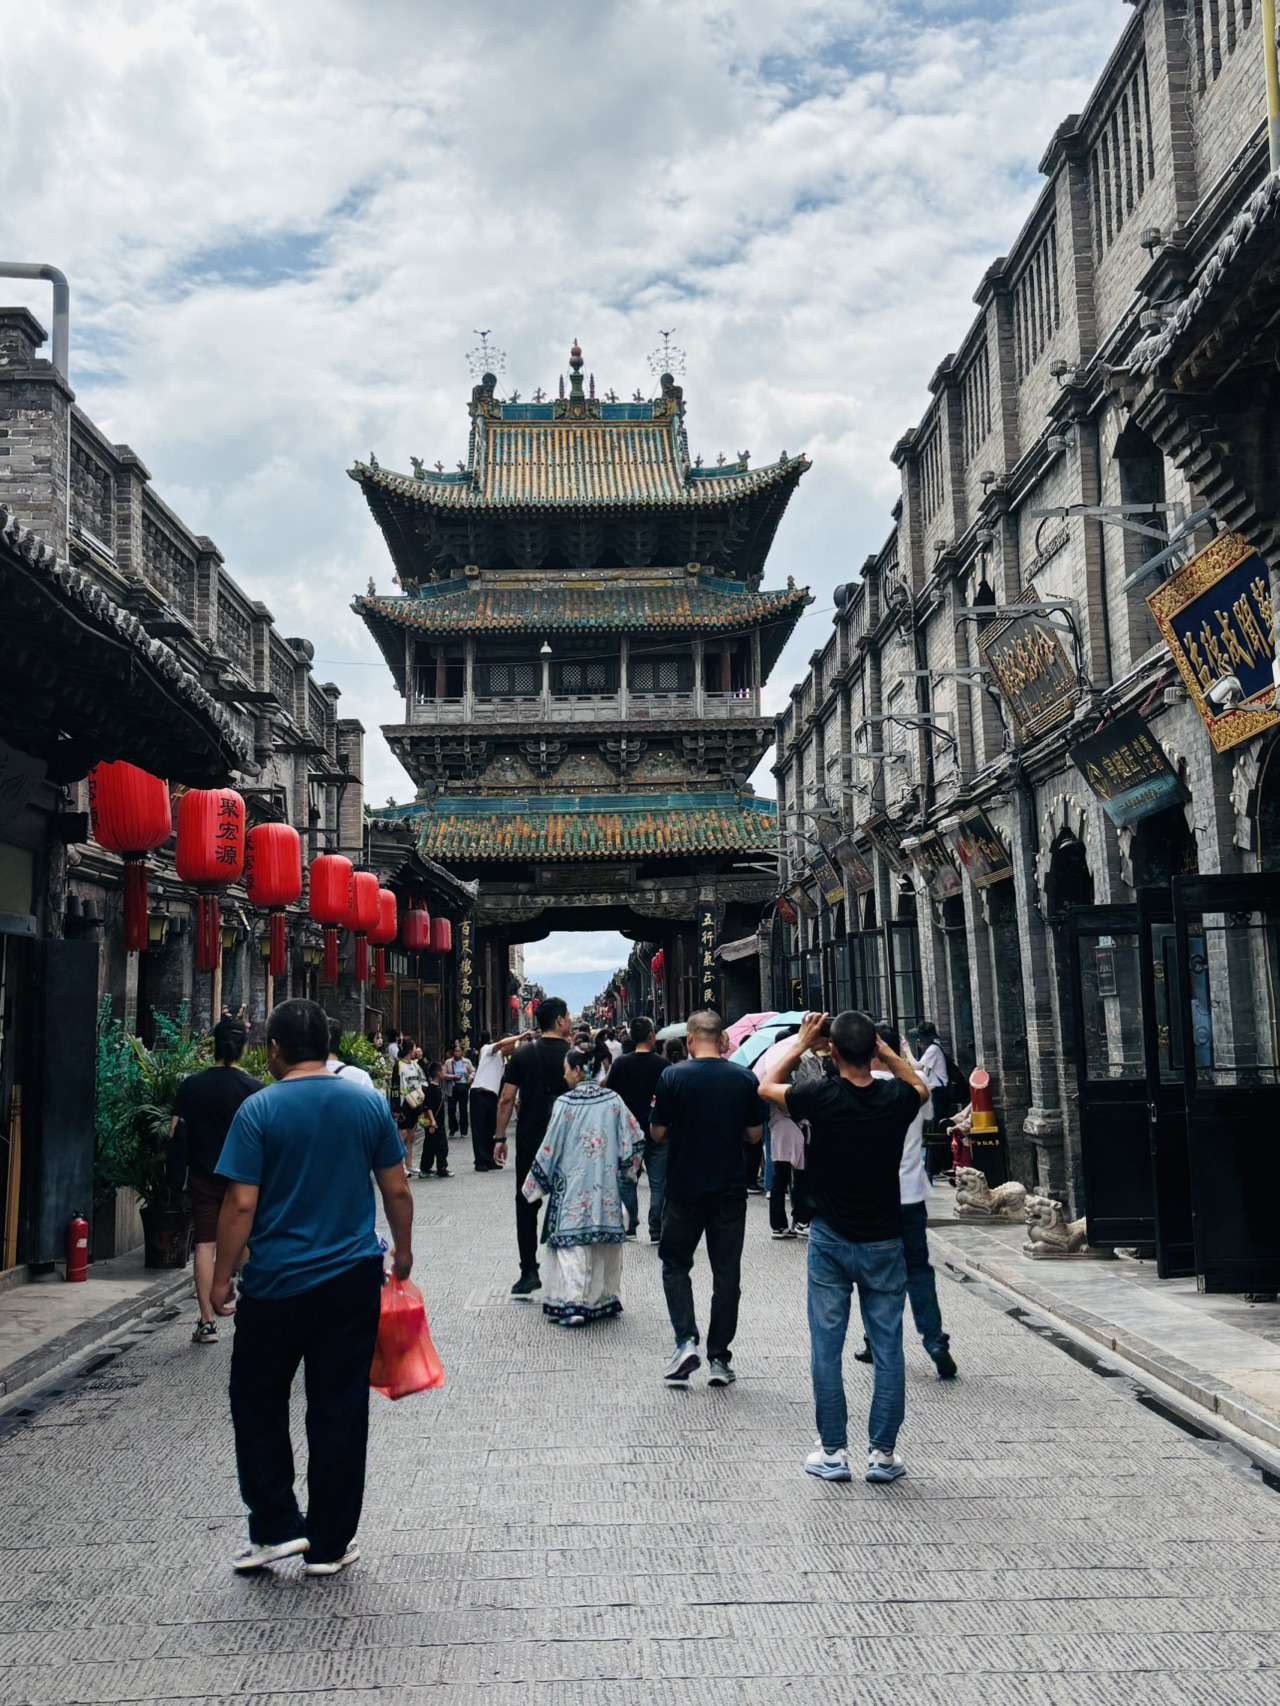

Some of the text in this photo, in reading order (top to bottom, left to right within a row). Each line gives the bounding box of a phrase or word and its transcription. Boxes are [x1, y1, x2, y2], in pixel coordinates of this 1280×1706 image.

[215, 797, 240, 866] 聚宏源
[701, 912, 716, 1011] 五行氣正民
